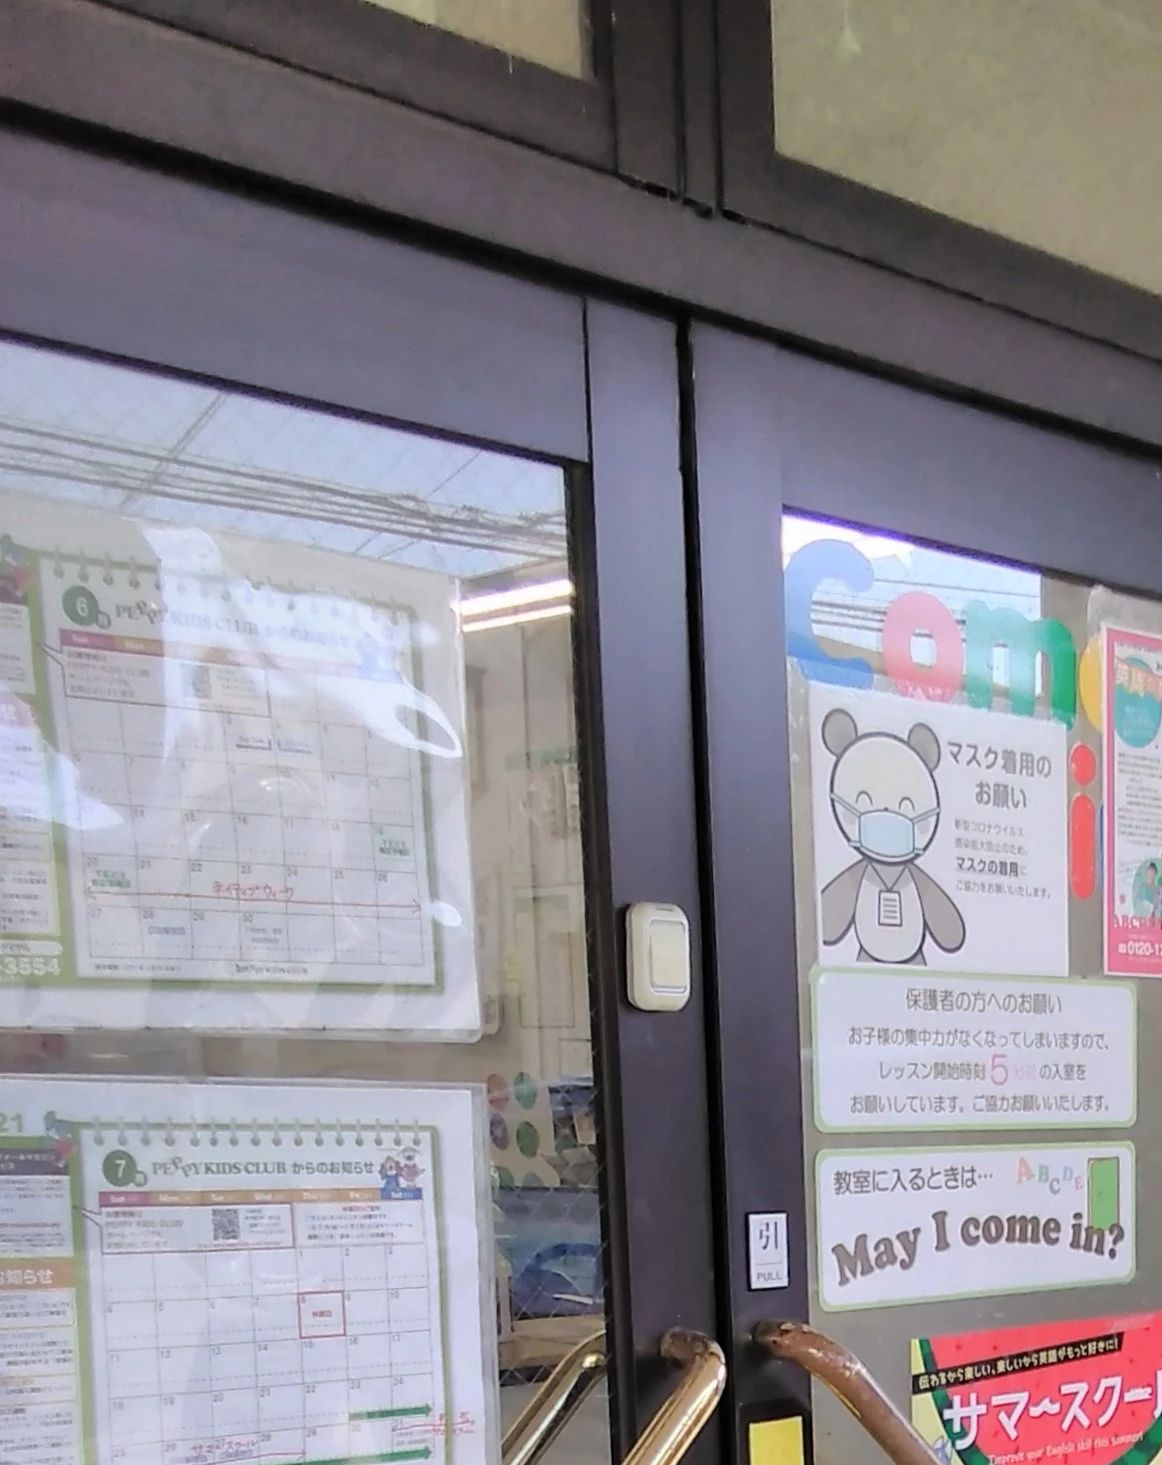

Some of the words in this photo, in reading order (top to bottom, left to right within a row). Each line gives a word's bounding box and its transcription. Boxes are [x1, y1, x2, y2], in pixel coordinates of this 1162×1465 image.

[76, 602, 88, 617] 6
[215, 615, 260, 635] CLUB
[947, 741, 1051, 778] マスク着用の
[976, 780, 1027, 810] お願い
[905, 988, 1063, 1015] 保護者の方へのお願い
[848, 1026, 1111, 1050] お子様の集中力がなくなってしまいますので、
[115, 1160, 126, 1177] 7
[152, 1156, 202, 1178] PEPPY
[205, 1161, 241, 1175] KIDS
[245, 1161, 286, 1175] CLUB
[292, 1160, 374, 1175] からのお知らせ
[758, 1221, 780, 1251] 引
[831, 1226, 922, 1287] May
[931, 1211, 950, 1252] I
[960, 1213, 1062, 1246] come
[1069, 1212, 1126, 1260] in?
[756, 1272, 783, 1282] PULL
[1046, 1442, 1075, 1460] English
[1077, 1439, 1092, 1453] skill
